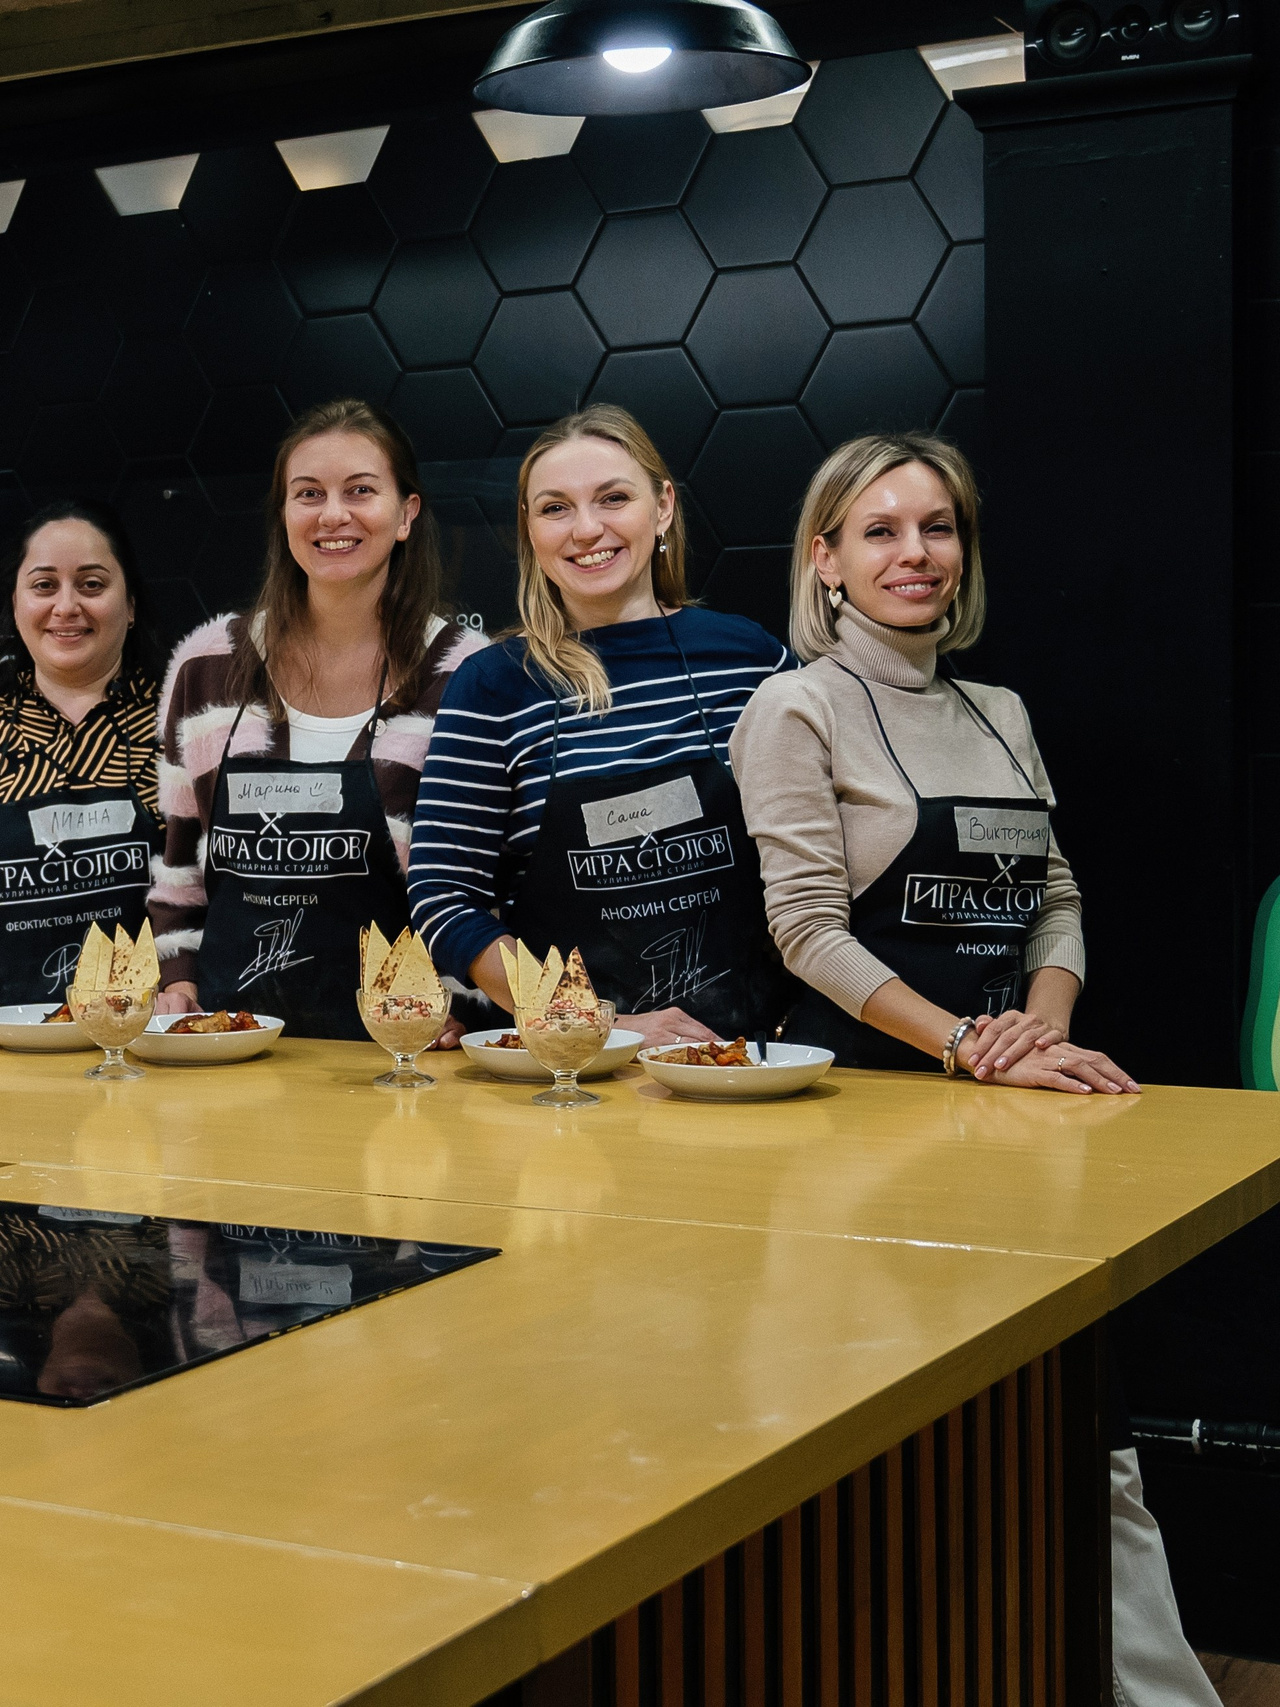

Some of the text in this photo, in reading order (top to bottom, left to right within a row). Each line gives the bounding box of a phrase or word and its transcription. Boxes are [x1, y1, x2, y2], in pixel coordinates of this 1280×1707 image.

[238, 783, 300, 800] Марина
[51, 808, 111, 834] ЛИАНА
[607, 807, 653, 826] Саша
[212, 832, 361, 862] ИГРА СТОЛОВ
[573, 833, 726, 877] ИГРА СТОЛОВ
[40, 848, 144, 883] СТОЛОВ
[284, 863, 329, 873] СТУДИЯ
[73, 876, 116, 891] СТУДИЯ
[596, 870, 662, 885] КУЛИНАРНАЯ
[273, 893, 318, 906] СЕРГЕЙ
[600, 887, 720, 921] АНОХИН СЕРГЕЙ
[913, 881, 979, 910] ИГРА
[5, 906, 122, 932] ФЕОКТИСТОВ АЛЕКСЕЙ
[941, 911, 1014, 921] КУЛИНАРНАЯ
